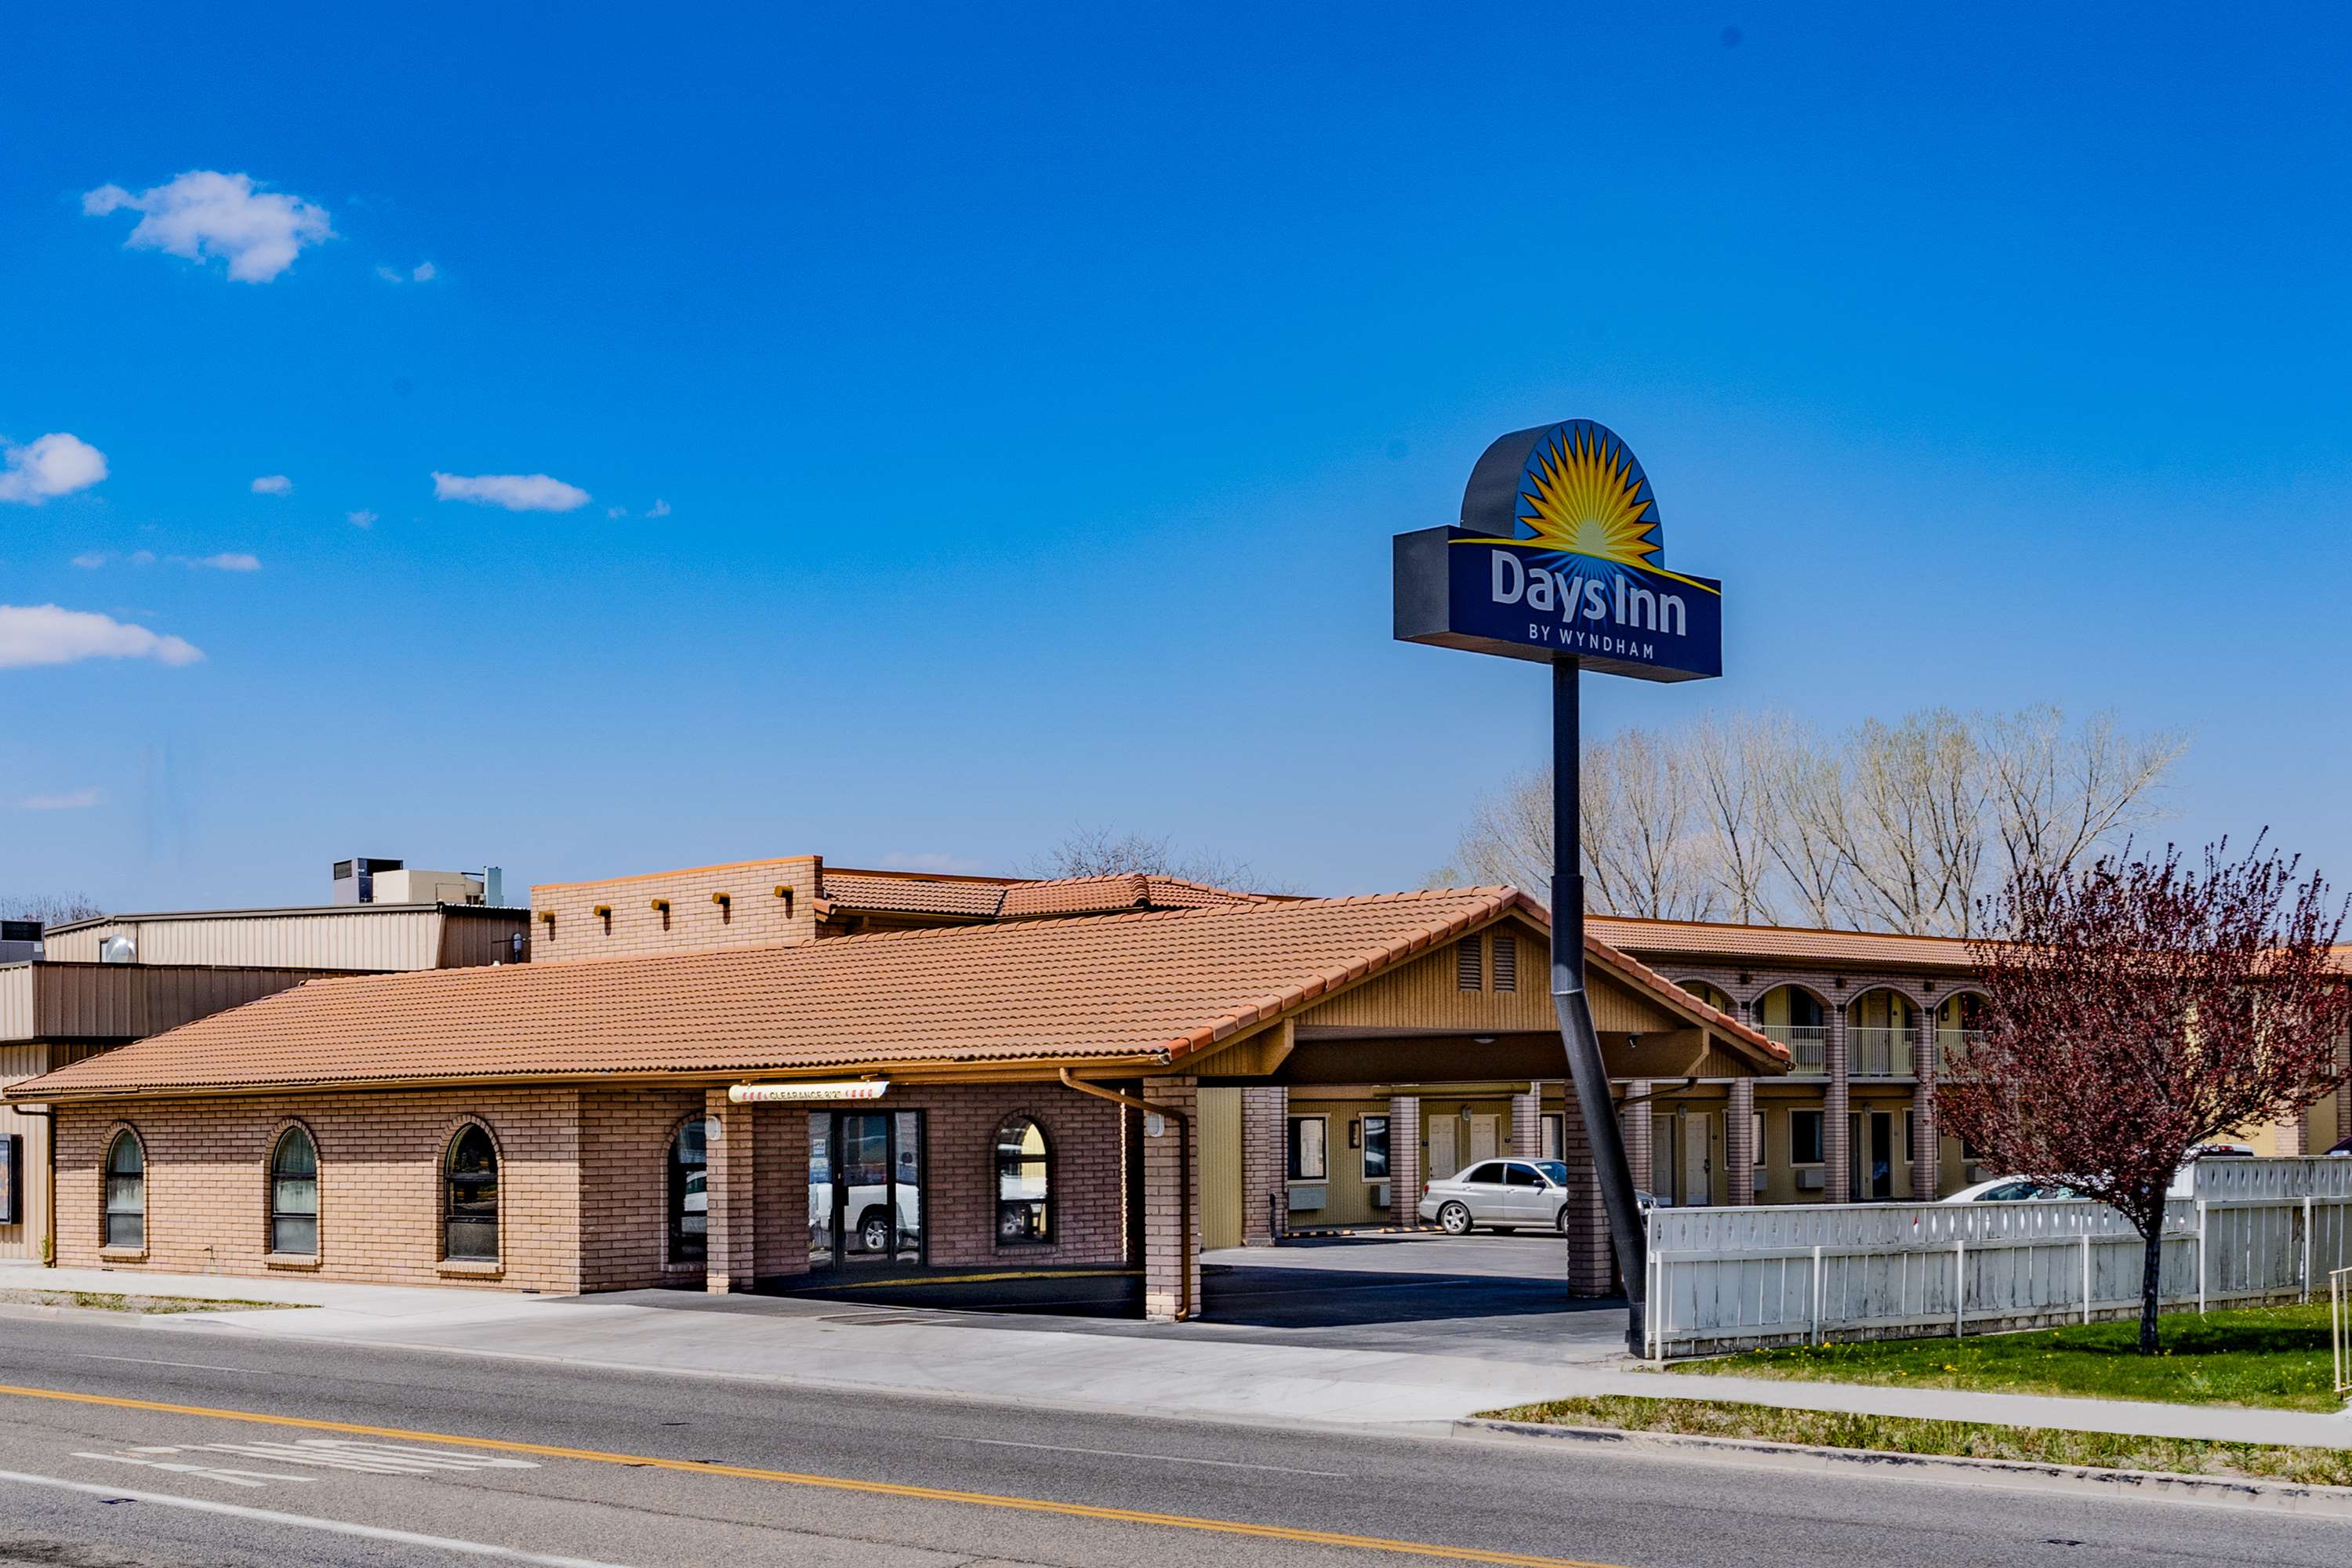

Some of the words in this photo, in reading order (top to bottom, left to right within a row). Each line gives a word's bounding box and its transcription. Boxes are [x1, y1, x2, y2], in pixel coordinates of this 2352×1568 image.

[1491, 550, 1606, 623] Days
[1615, 575, 1686, 637] Inn
[1529, 624, 1550, 641] BY
[1559, 629, 1653, 659] WYNDHAM
[770, 1091, 822, 1099] CLEARANCE
